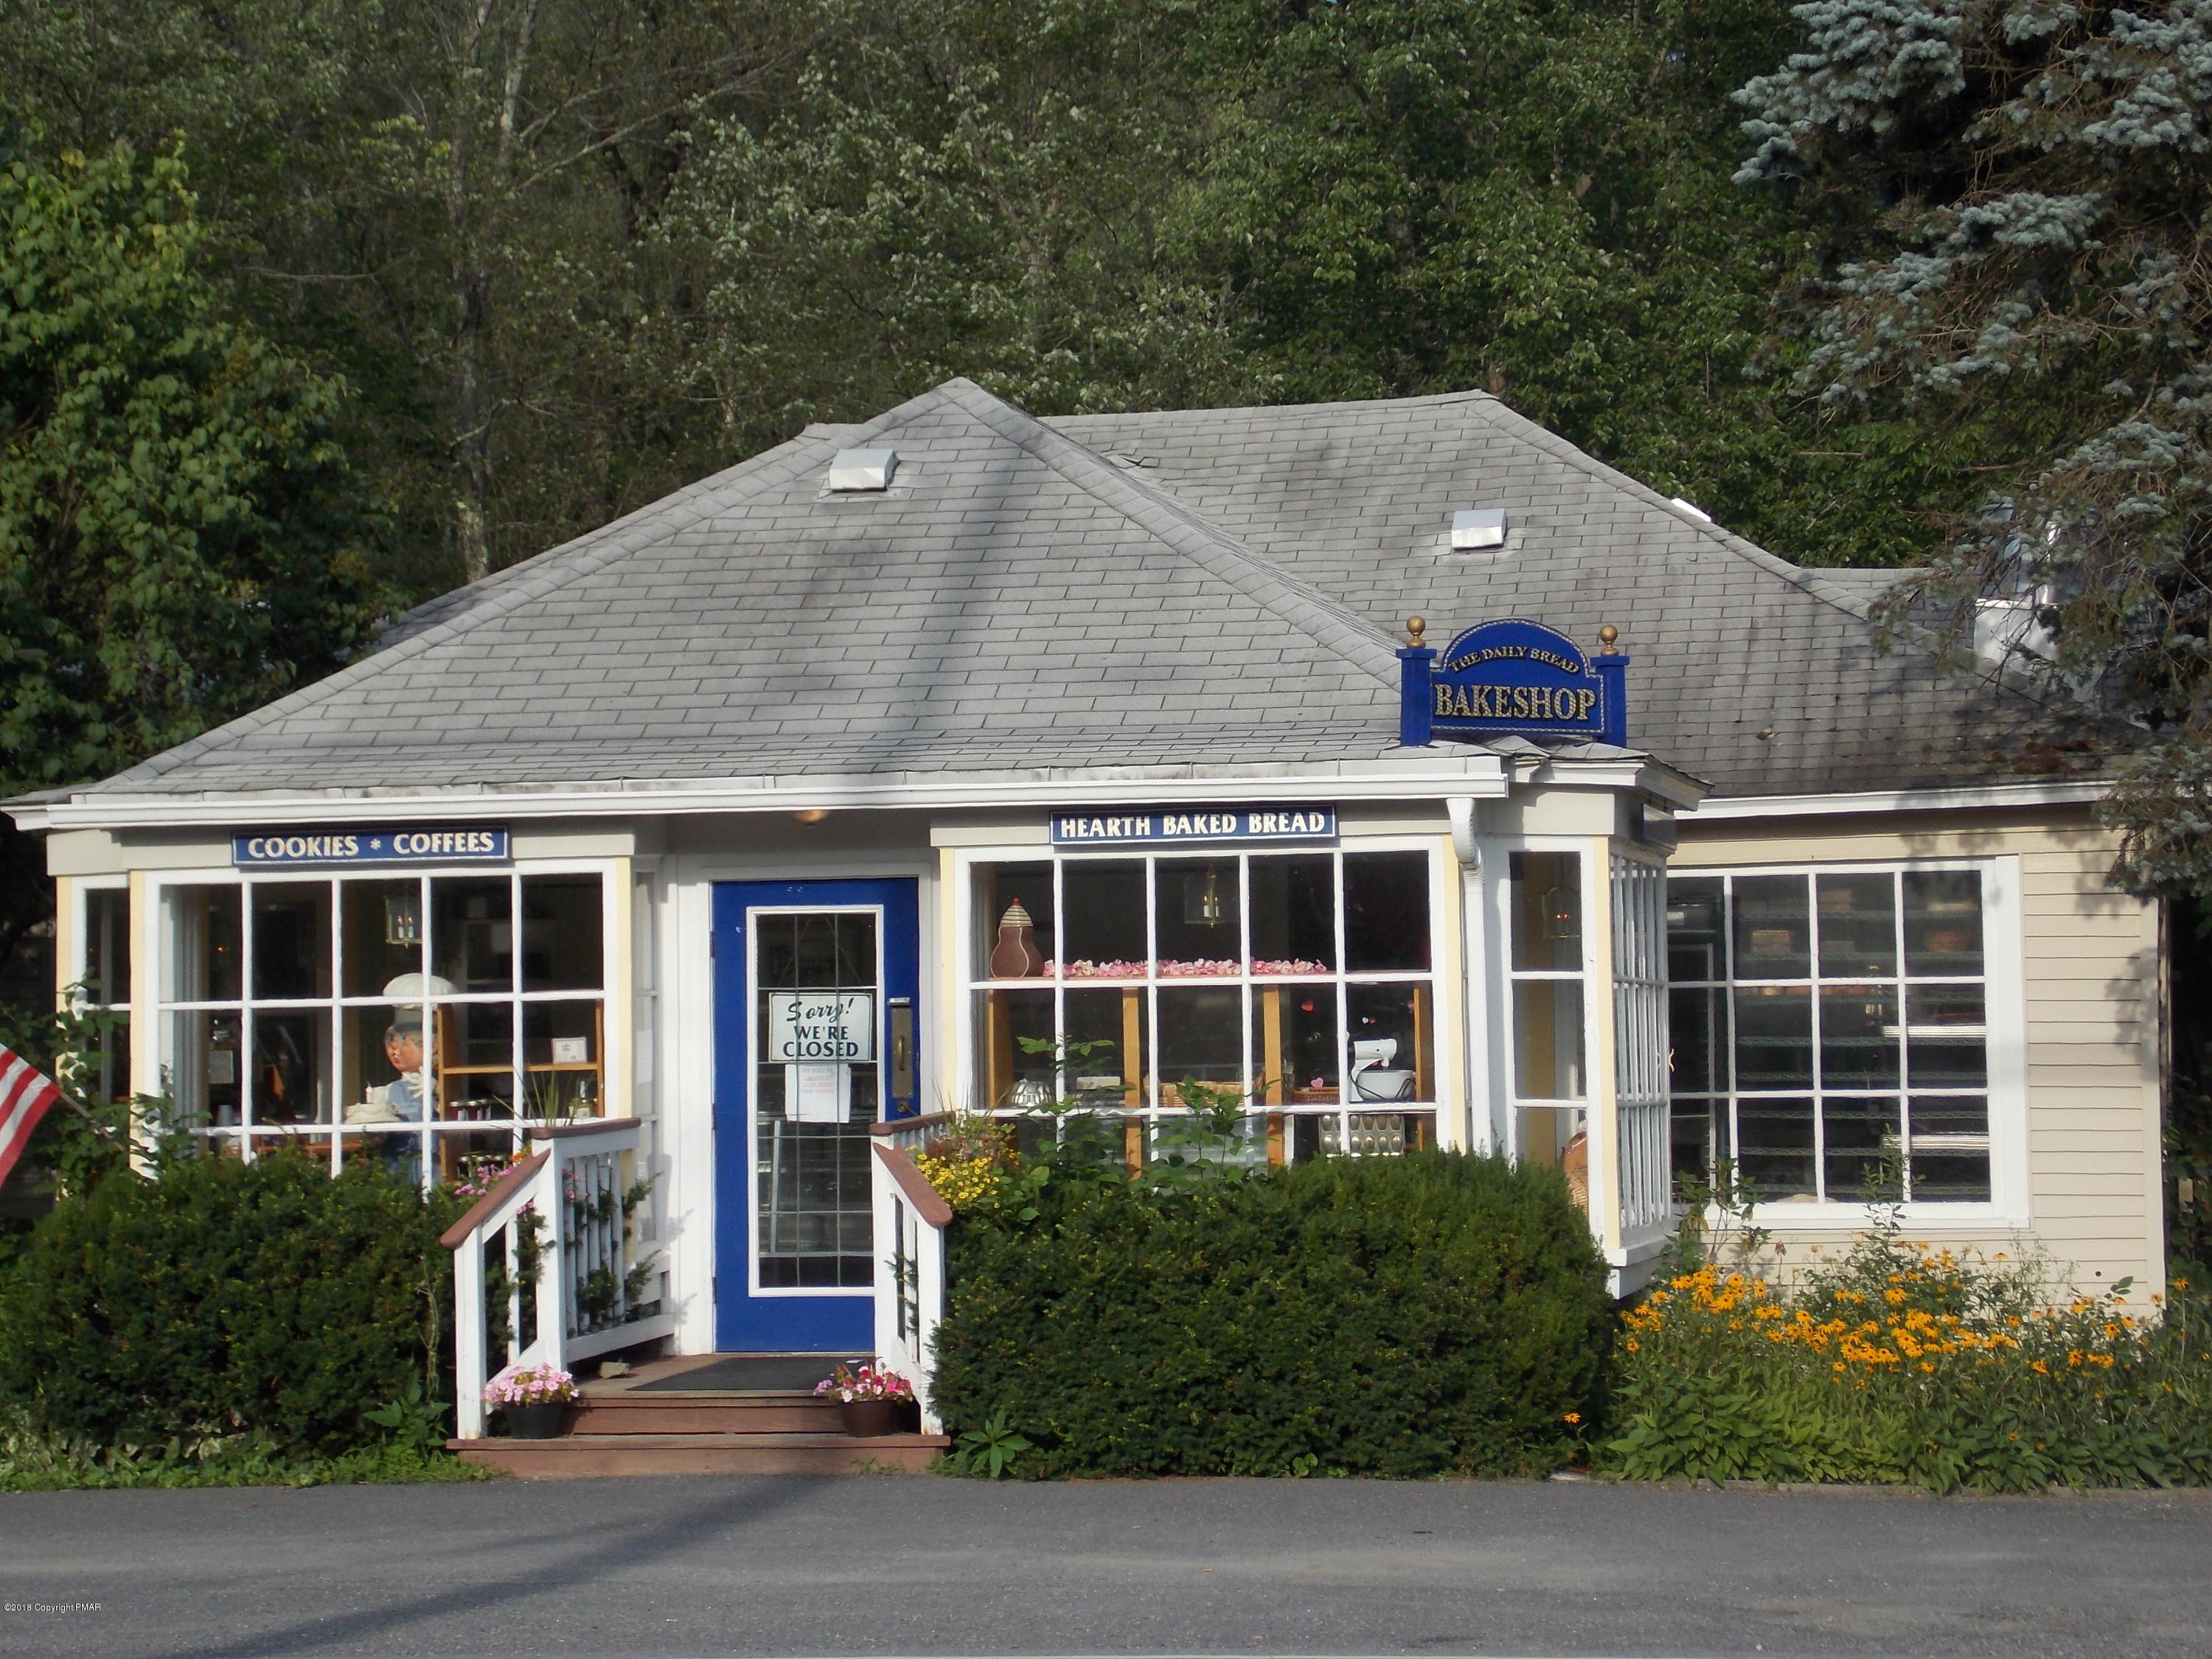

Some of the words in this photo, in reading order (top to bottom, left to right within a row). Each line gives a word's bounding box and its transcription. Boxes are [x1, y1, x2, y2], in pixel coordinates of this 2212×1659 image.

[1449, 653, 1481, 672] THE
[1483, 646, 1528, 660] DAILY
[1530, 649, 1579, 673] BREAD
[1435, 684, 1596, 720] BAKESHOP
[1060, 815, 1150, 838] HEARTH
[1162, 813, 1237, 835] BAKED
[1248, 811, 1326, 833] BREAD
[248, 836, 359, 858] COOKIES
[393, 832, 495, 855] COFFEES
[786, 998, 855, 1023] Sorry!
[793, 1026, 849, 1040] WE'RE
[783, 1041, 859, 1057] CLOSED
